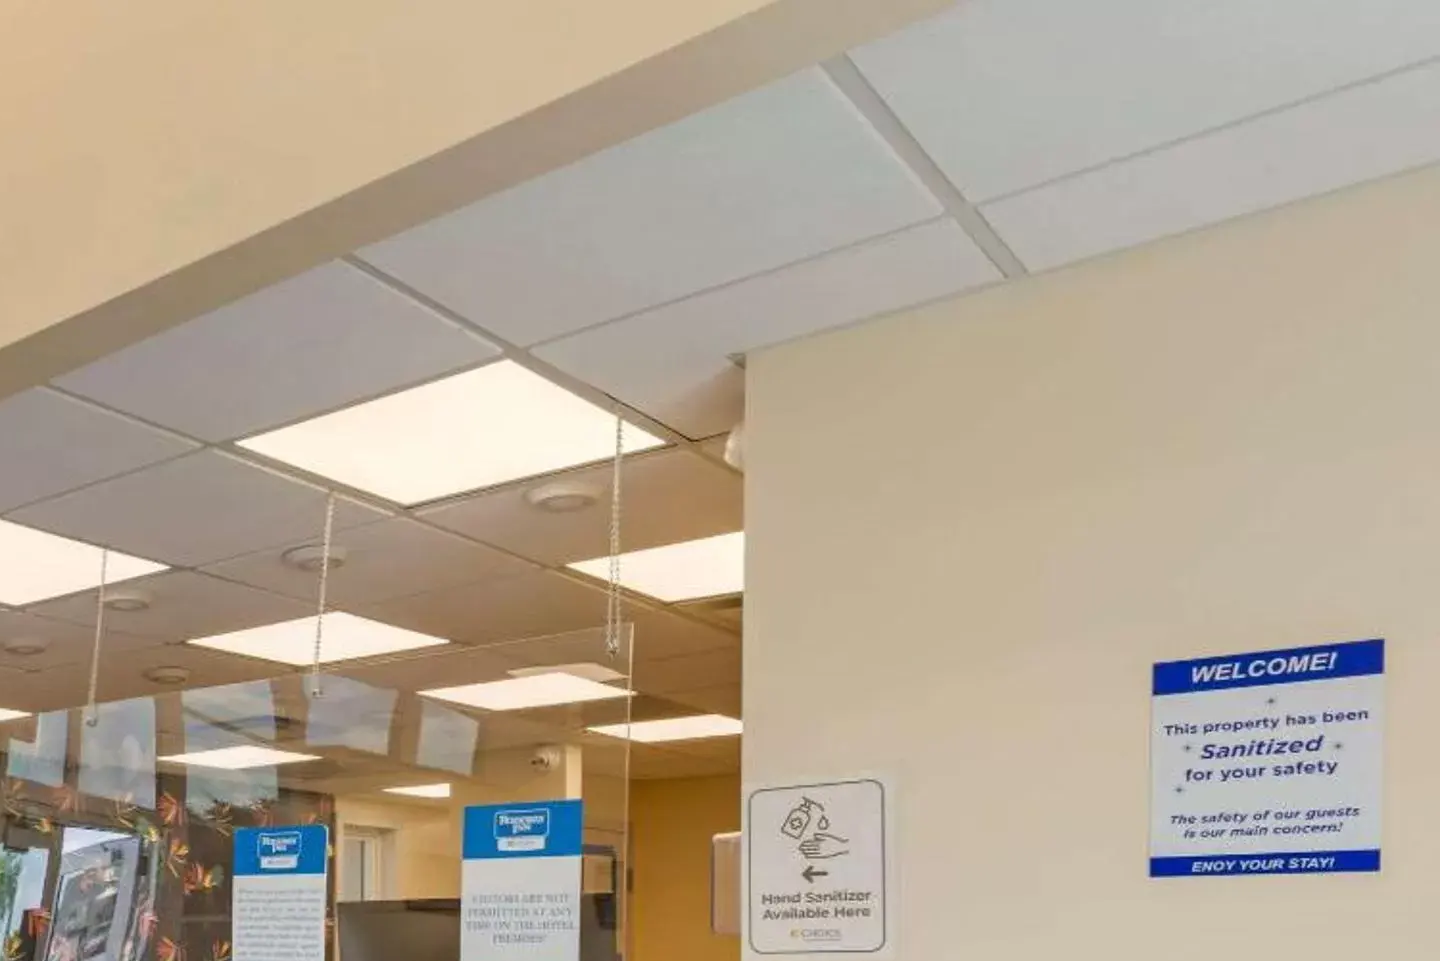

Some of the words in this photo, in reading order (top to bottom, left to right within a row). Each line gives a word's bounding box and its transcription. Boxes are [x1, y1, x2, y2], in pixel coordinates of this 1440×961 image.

[1191, 652, 1338, 684] WELCOME!
[1164, 724, 1197, 736] This
[1203, 716, 1280, 736] property
[1286, 711, 1315, 726] has
[1323, 709, 1369, 723] been
[1201, 735, 1325, 760] Sanitized
[1185, 768, 1214, 782] for
[1221, 764, 1266, 782] your
[1273, 759, 1339, 777] safety
[1170, 814, 1197, 825] The
[1201, 812, 1248, 825] safety
[1253, 809, 1270, 821] of
[1274, 809, 1300, 820] our
[1306, 806, 1361, 821] guests
[1200, 828, 1226, 838] our
[1230, 825, 1268, 837] main
[1272, 821, 1343, 836] concern!
[1239, 858, 1284, 871] YOUR
[1288, 856, 1336, 869] STAY!
[761, 892, 801, 905] Hand
[805, 891, 871, 904] Sanitizer
[762, 907, 830, 920] Available
[834, 905, 871, 917] Here
